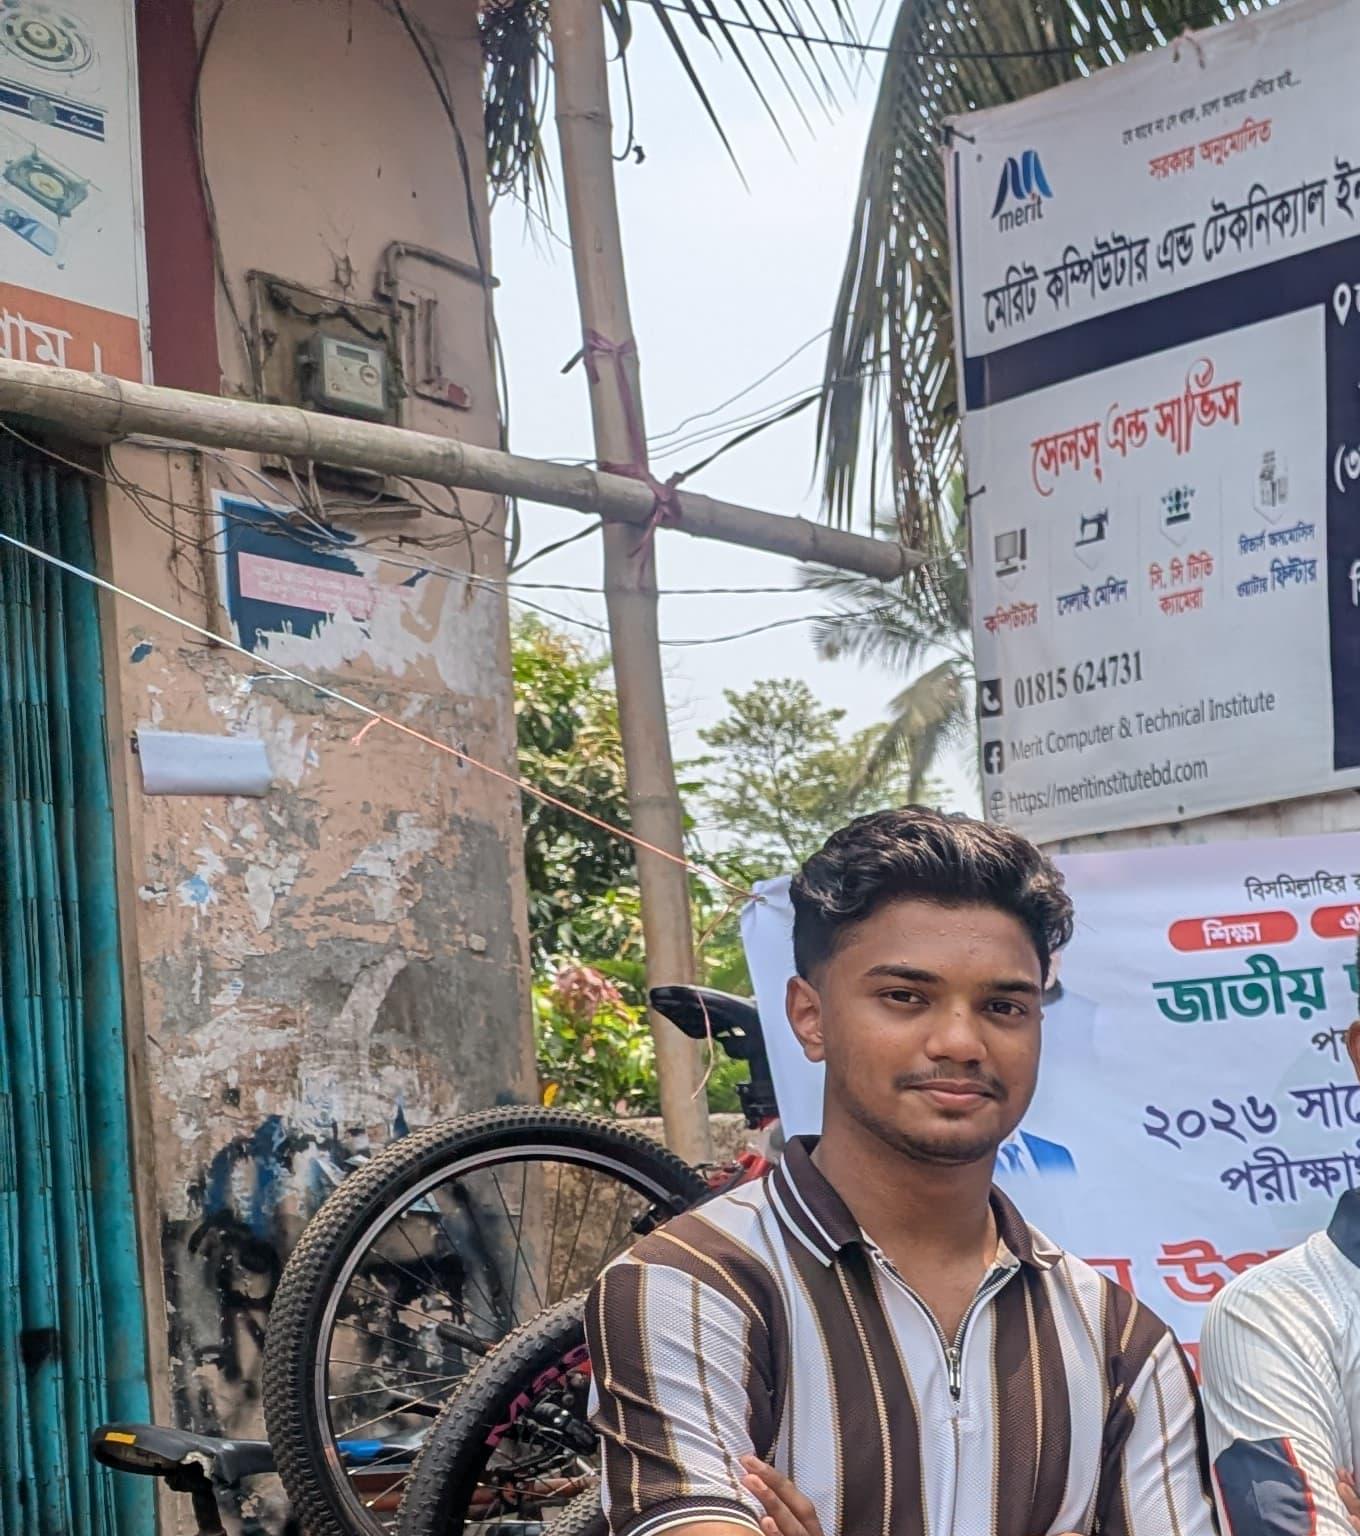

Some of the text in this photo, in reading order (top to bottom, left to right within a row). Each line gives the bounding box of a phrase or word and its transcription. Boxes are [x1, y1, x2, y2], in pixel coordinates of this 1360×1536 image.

[999, 200, 1044, 234] merit
[983, 261, 1039, 335] মেরিট
[1157, 222, 1196, 277] এন্ড
[1201, 179, 1328, 262] টেকনিক্যাল
[1013, 650, 1144, 710] 01815 624731
[1010, 689, 1276, 762] Merit Computer & Technical Institute
[1203, 918, 1262, 946] শিক্ষা
[1153, 954, 1327, 1023] জাতীয়
[1142, 1095, 1278, 1150] ২০২৬
